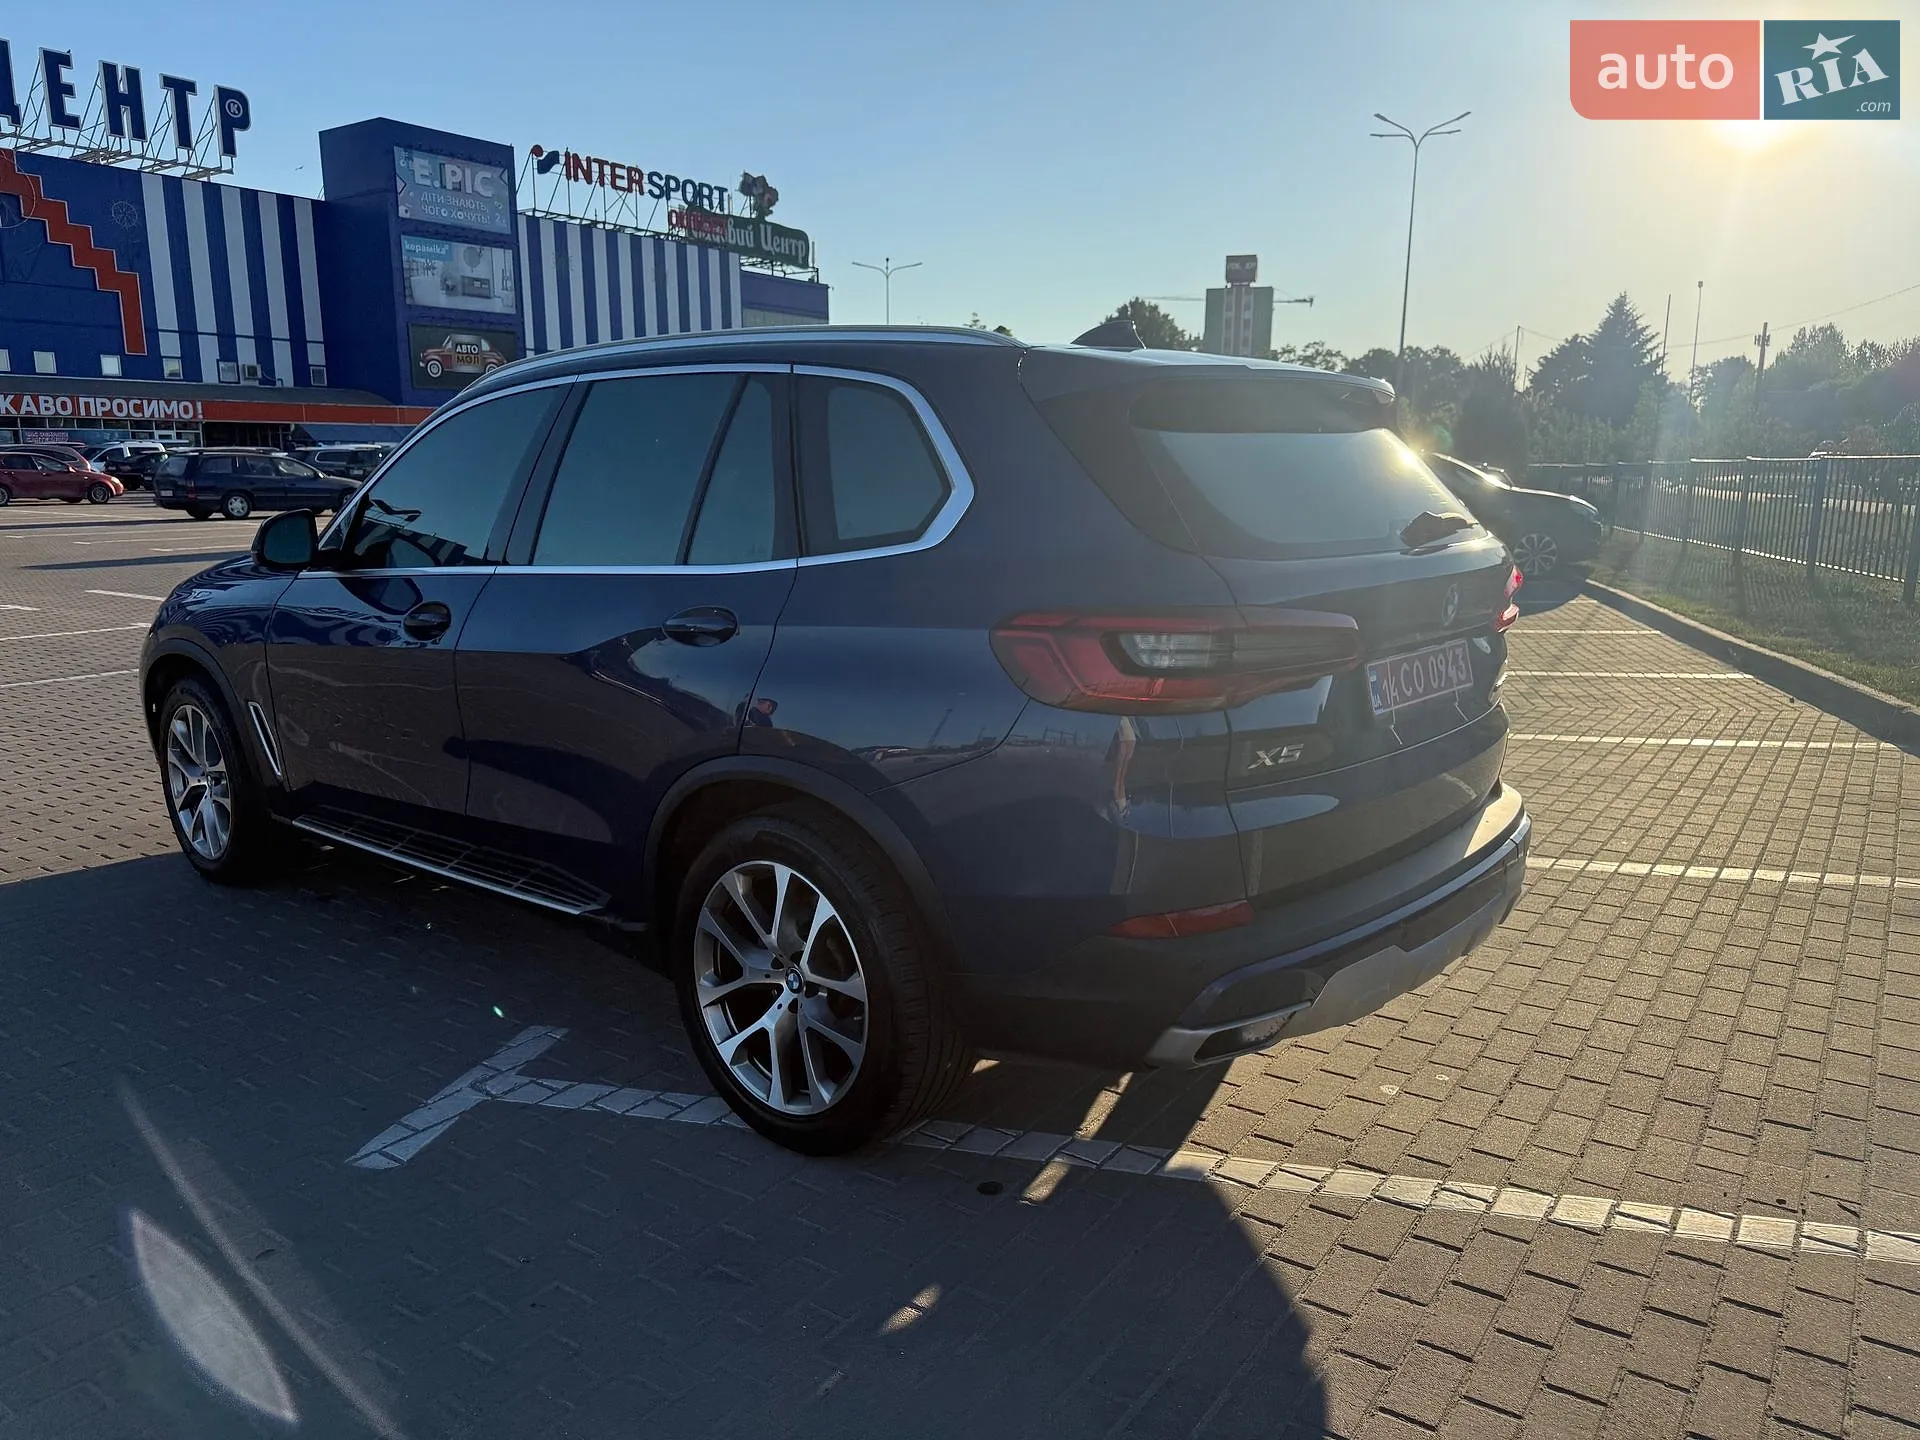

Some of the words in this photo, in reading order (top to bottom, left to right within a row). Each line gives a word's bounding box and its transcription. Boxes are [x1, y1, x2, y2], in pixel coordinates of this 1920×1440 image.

[564, 149, 728, 212] INTERSPORT
[760, 222, 806, 264] Центр
[456, 344, 479, 354] АВТО
[1248, 744, 1304, 769] X5
